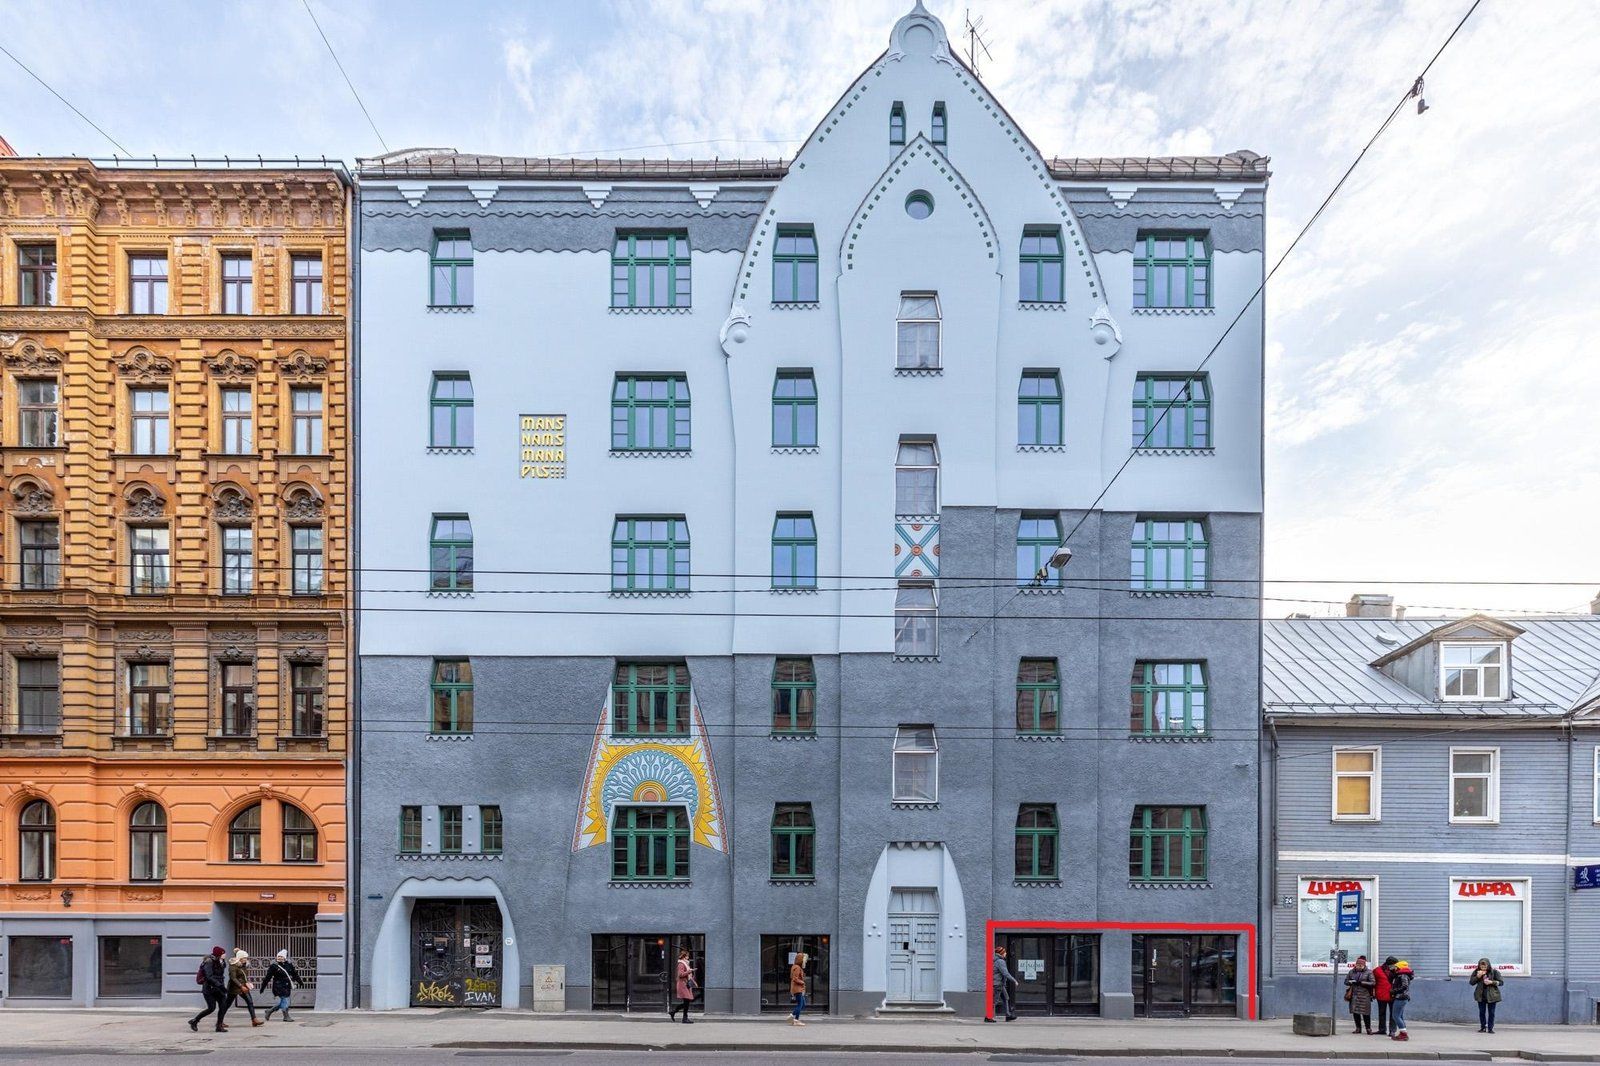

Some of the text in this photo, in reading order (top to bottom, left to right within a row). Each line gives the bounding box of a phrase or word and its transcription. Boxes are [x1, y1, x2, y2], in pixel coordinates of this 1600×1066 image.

[522, 417, 564, 431] MANS
[522, 434, 564, 446] NAMS
[522, 450, 564, 462] MANA
[522, 465, 550, 478] PILS
[1307, 881, 1362, 895] LUPPA
[1458, 882, 1516, 897] LUPPA
[464, 992, 496, 1003] IVAN
